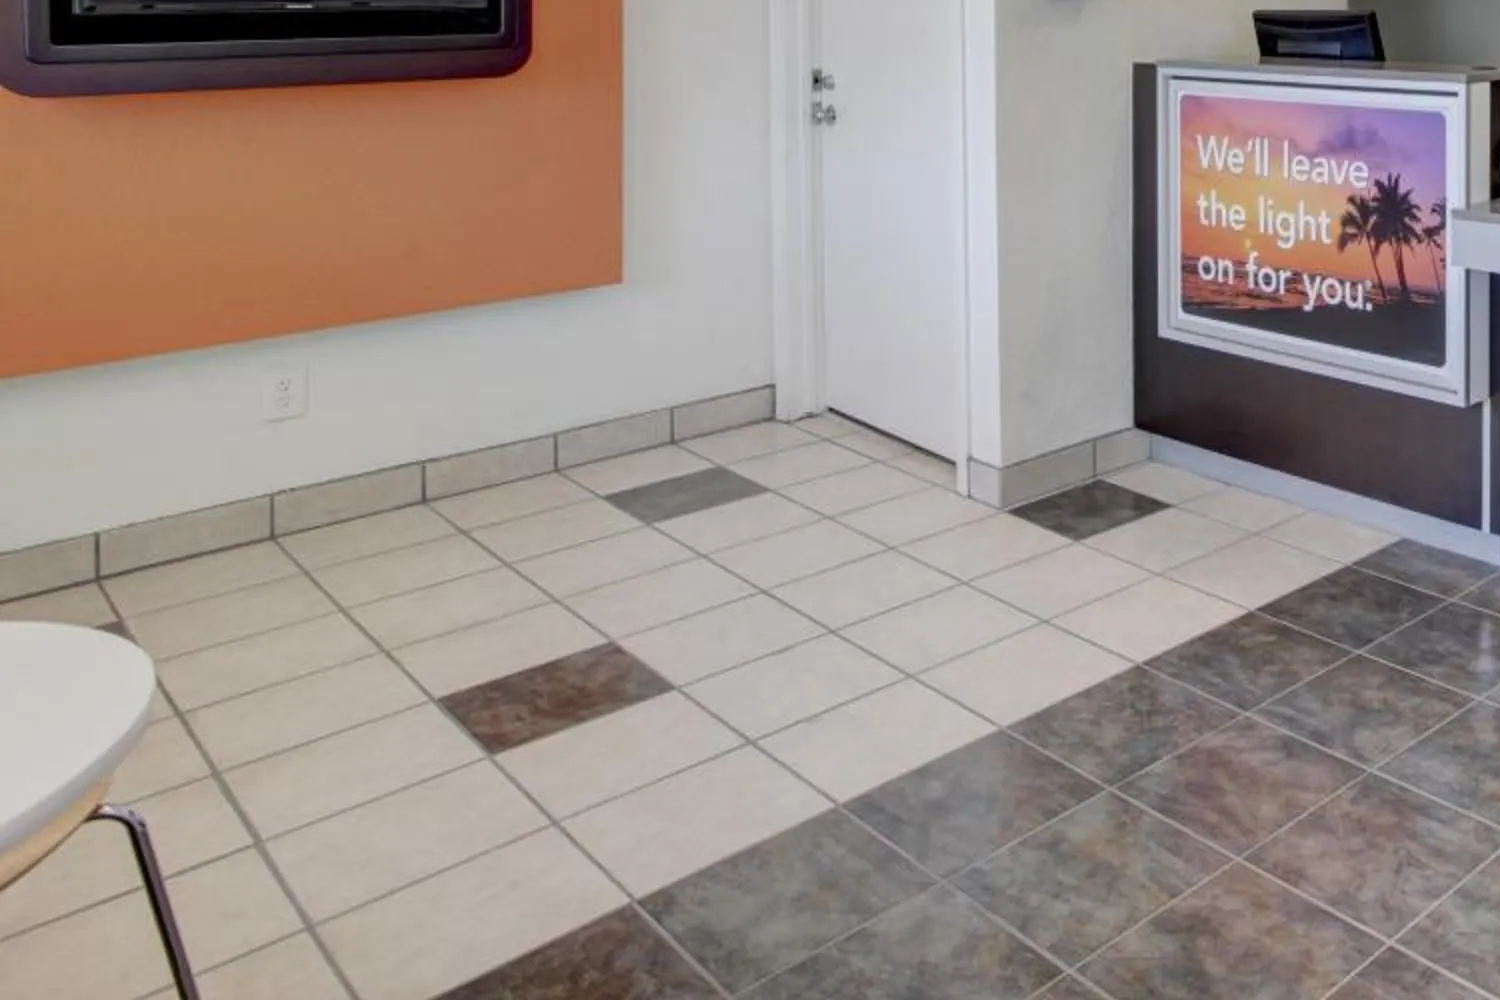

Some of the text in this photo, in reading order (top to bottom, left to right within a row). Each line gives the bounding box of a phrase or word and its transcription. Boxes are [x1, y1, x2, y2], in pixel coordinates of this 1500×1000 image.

[1196, 134, 1369, 188] We'll leave
[1196, 190, 1332, 250] the light
[1197, 255, 1235, 285] on
[1246, 251, 1293, 294] for
